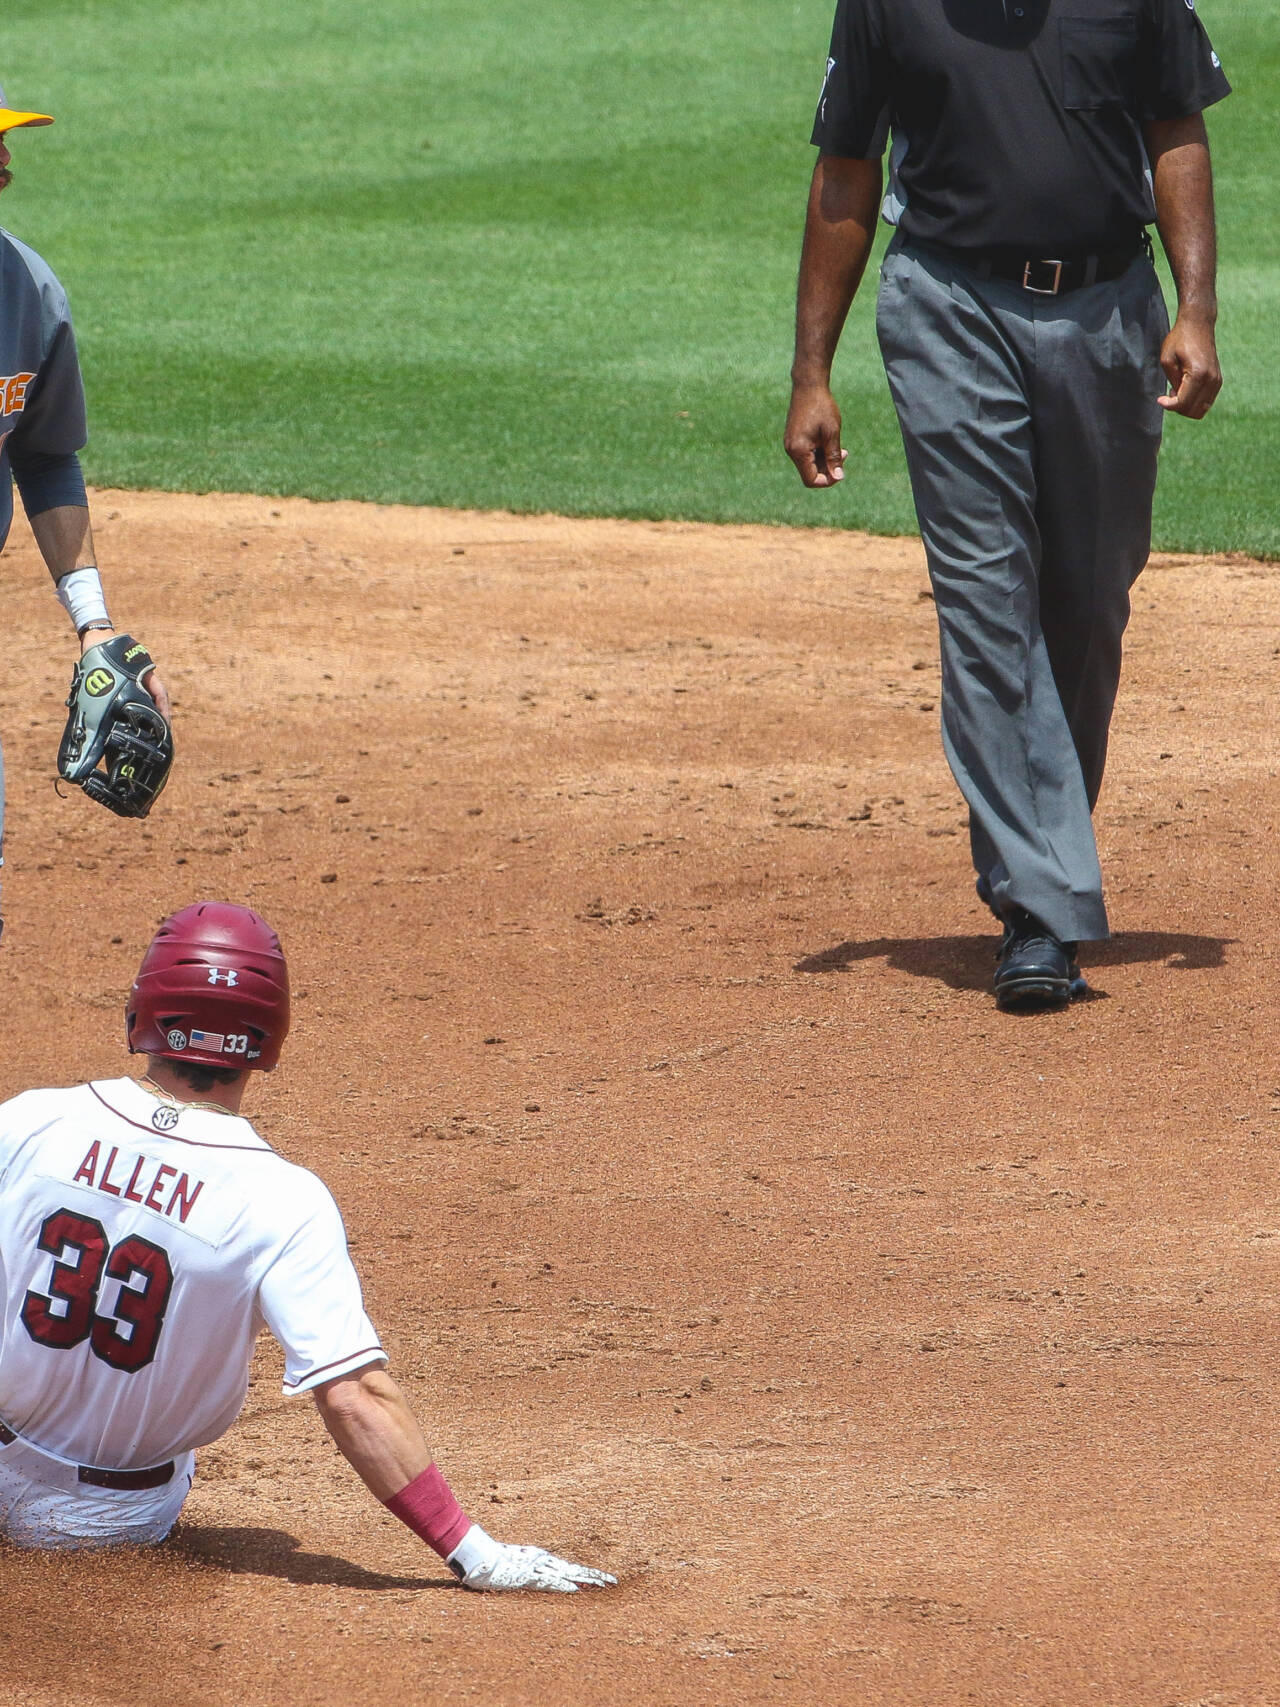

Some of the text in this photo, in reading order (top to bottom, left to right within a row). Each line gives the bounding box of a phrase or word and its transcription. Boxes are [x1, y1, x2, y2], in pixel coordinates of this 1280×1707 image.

[168, 1031, 186, 1050] SEC
[224, 1034, 248, 1053] 33
[73, 1140, 205, 1223] ALLEN
[20, 1207, 174, 1375] 33
